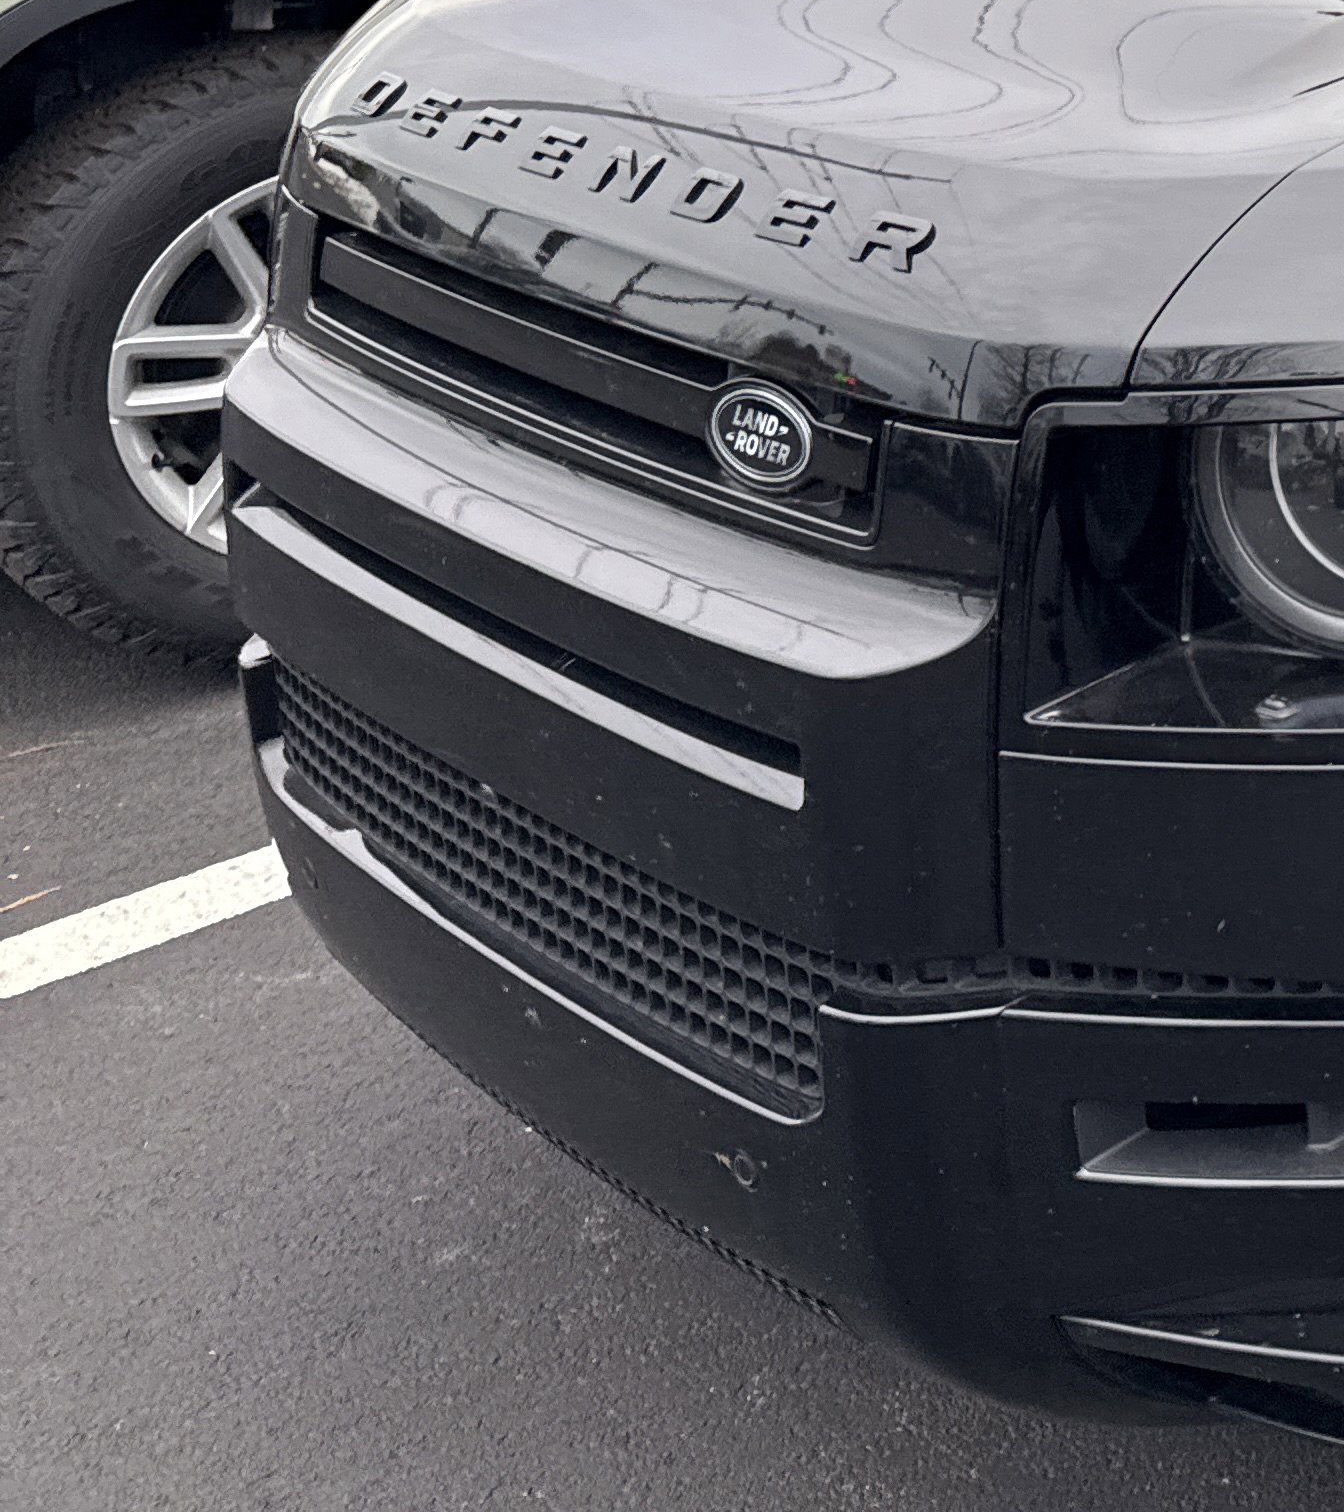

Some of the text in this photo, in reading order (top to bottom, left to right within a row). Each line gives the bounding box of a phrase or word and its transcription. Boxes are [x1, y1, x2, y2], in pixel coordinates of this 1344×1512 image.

[351, 71, 938, 274] DEFENDER
[731, 403, 780, 437] LAND
[733, 429, 791, 466] ROVER
